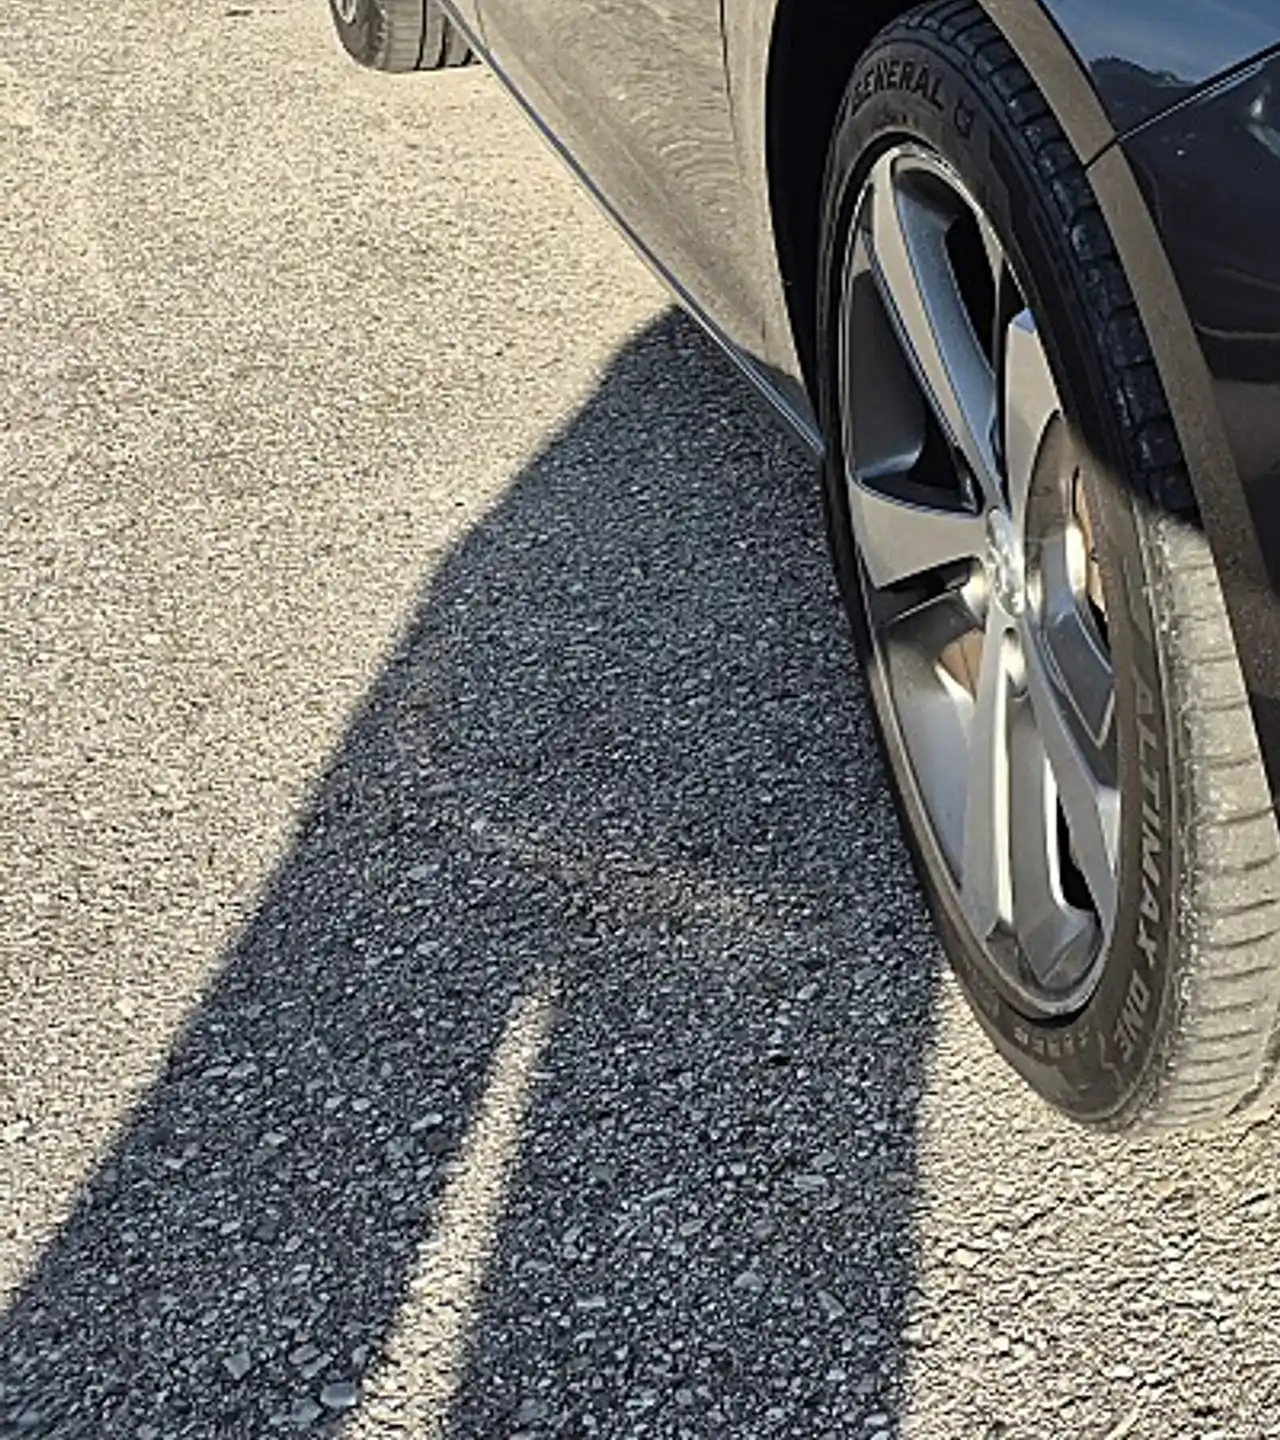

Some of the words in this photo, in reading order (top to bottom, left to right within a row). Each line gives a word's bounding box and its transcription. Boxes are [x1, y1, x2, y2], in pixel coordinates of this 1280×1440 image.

[852, 58, 945, 114] GENERAL
[1132, 666, 1165, 969] ALTIMAX
[1113, 968, 1152, 1056] ONE
